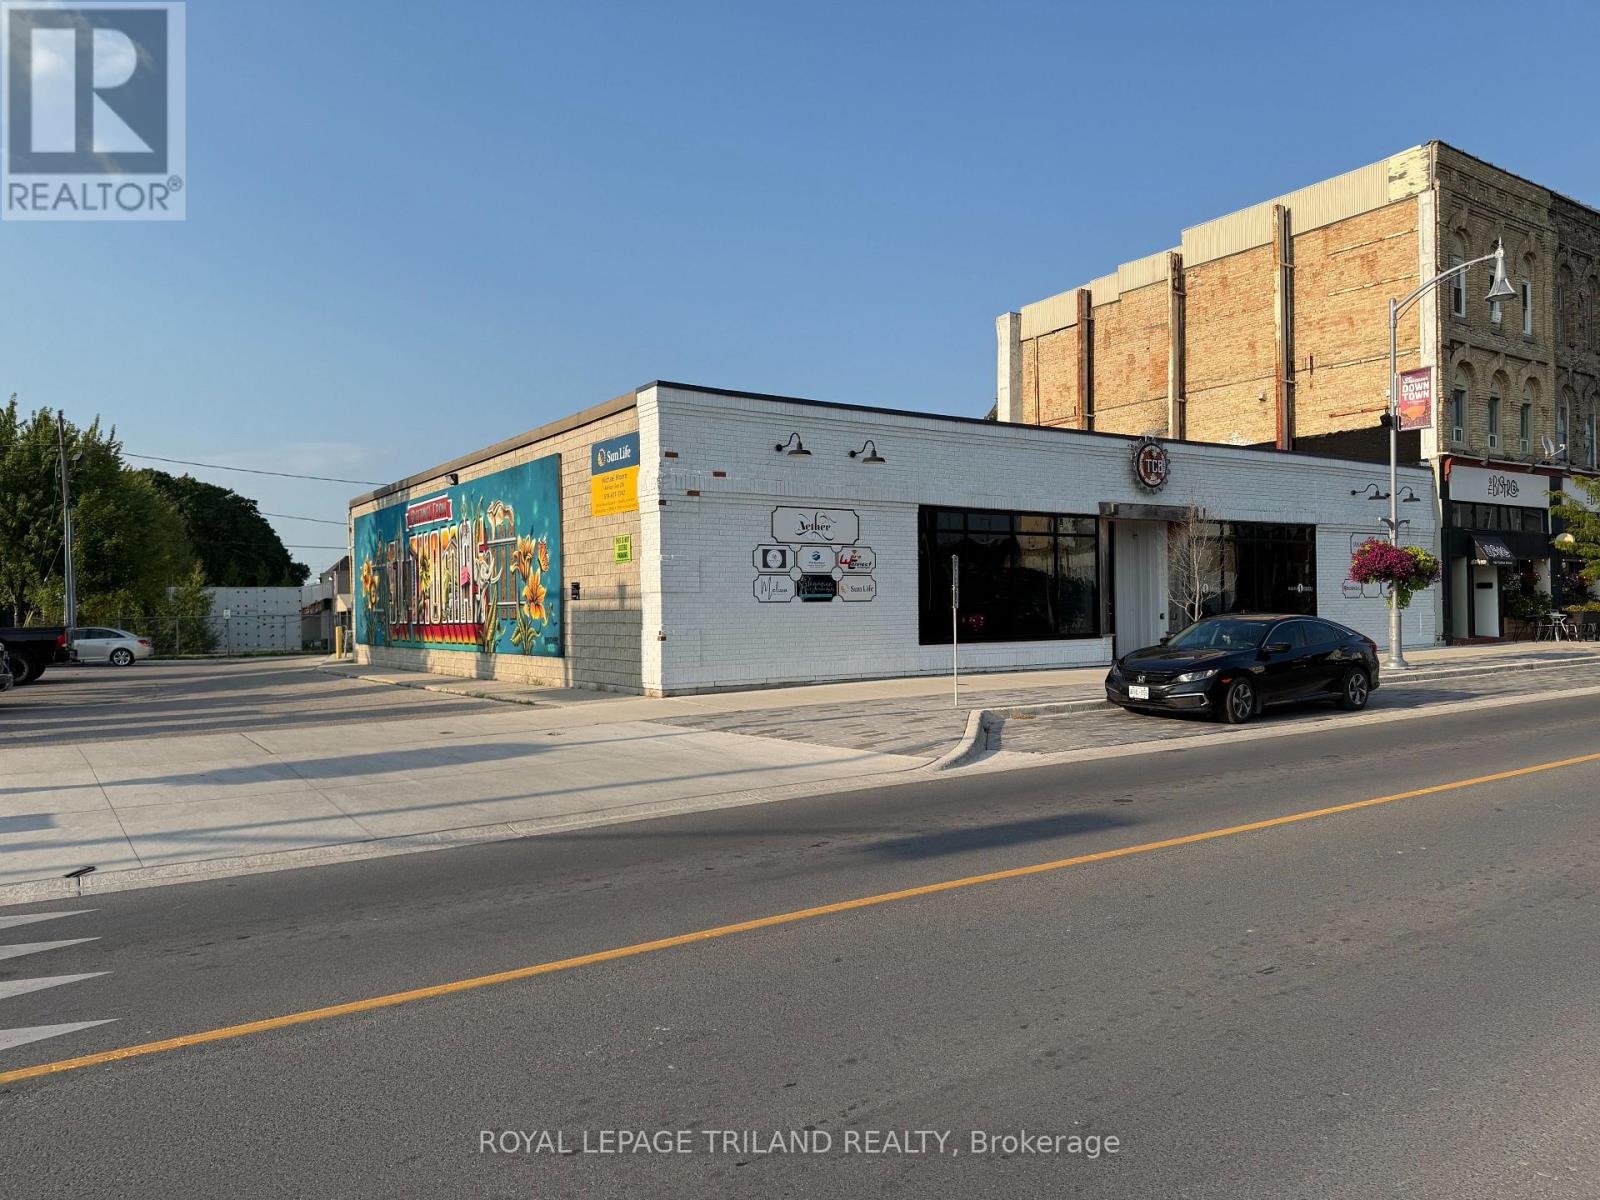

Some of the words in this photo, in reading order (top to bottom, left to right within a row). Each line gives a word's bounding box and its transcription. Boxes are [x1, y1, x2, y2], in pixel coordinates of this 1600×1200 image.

[1402, 381, 1430, 393] DOWN
[1402, 390, 1430, 401] TOWN
[606, 450, 618, 463] Sun
[619, 444, 631, 460] Life
[850, 584, 861, 593] Sun
[861, 584, 874, 593] Life
